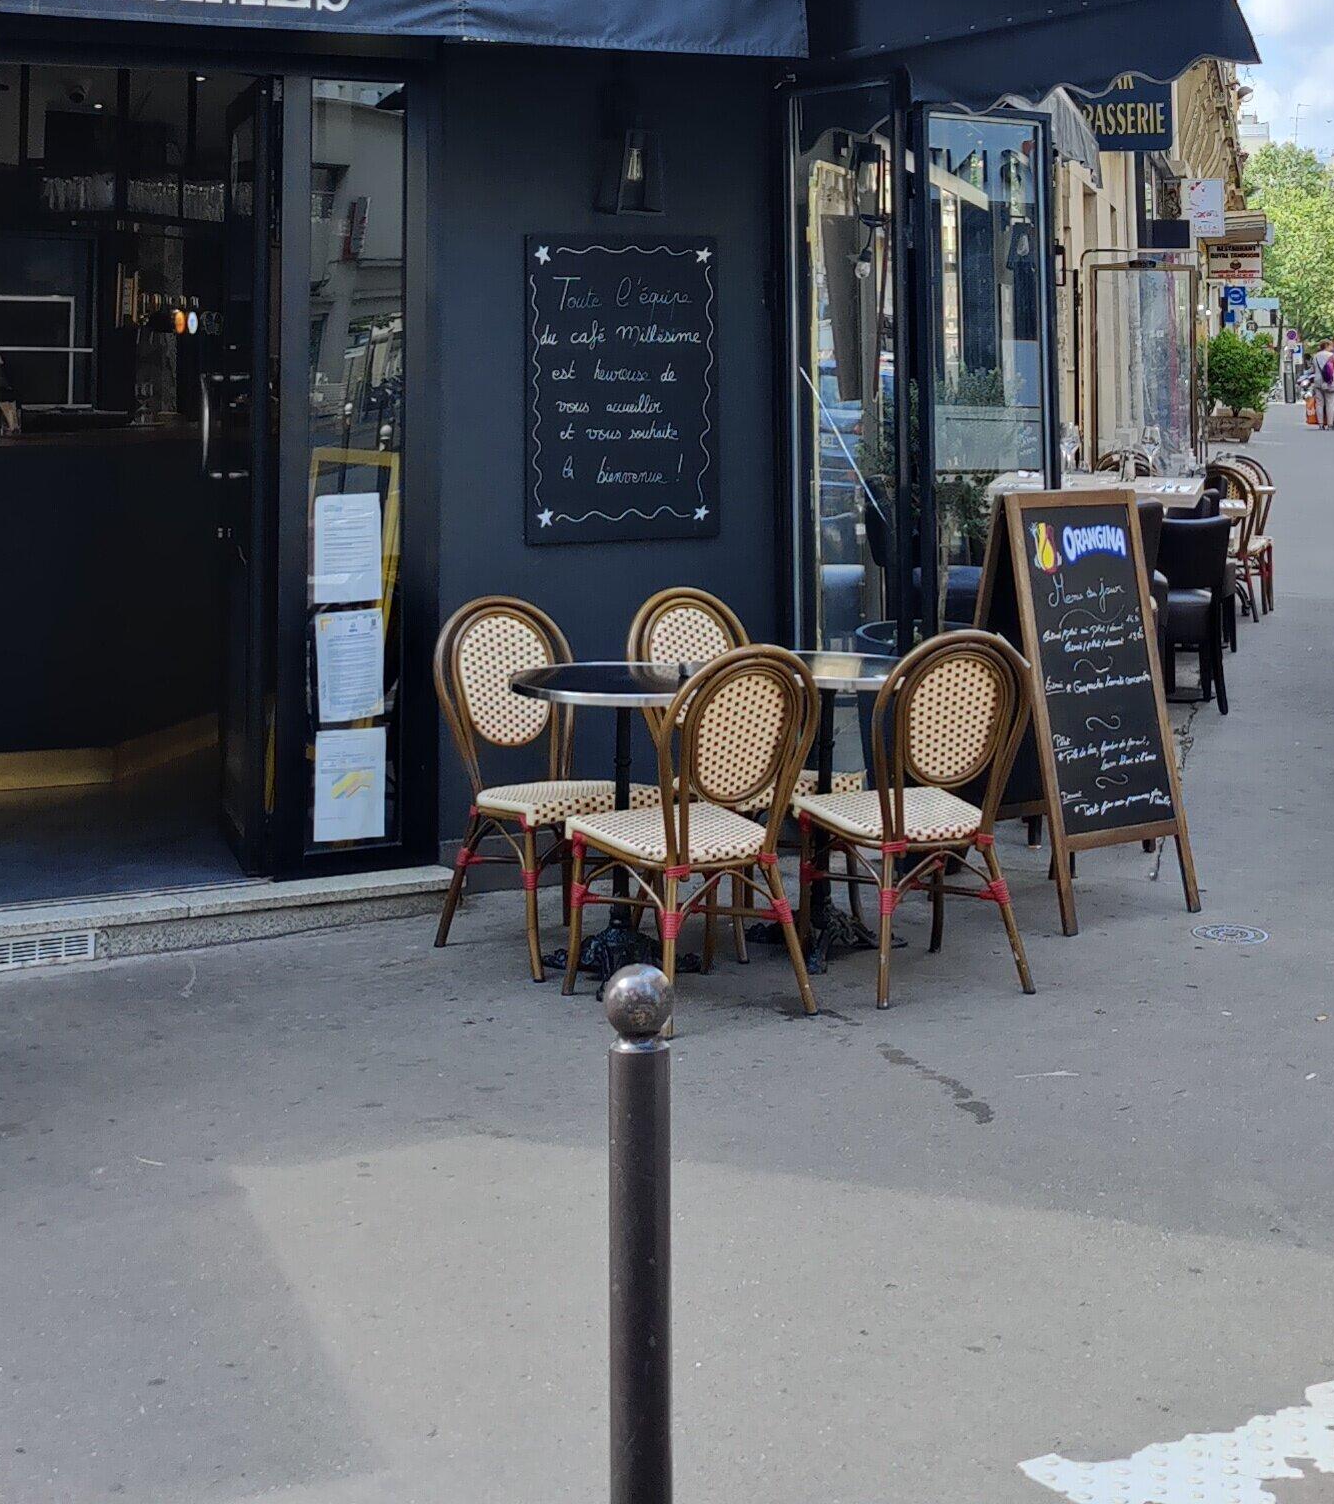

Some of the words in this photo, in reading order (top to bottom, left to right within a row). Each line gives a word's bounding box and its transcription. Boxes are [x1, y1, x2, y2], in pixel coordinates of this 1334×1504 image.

[1081, 102, 1166, 135] RASSERIE
[552, 276, 603, 311] Toute
[540, 324, 558, 346] du
[570, 320, 606, 350] café
[551, 360, 576, 380] est
[593, 358, 651, 382] heureuse
[660, 364, 677, 382] de
[555, 400, 590, 413] vous
[606, 394, 663, 414] accueillir
[559, 423, 574, 441] et
[585, 428, 622, 441] vous
[628, 420, 679, 441] souhaite
[562, 455, 575, 480] la
[596, 456, 668, 484] bienvenue
[1062, 524, 1126, 562] ORANGINA
